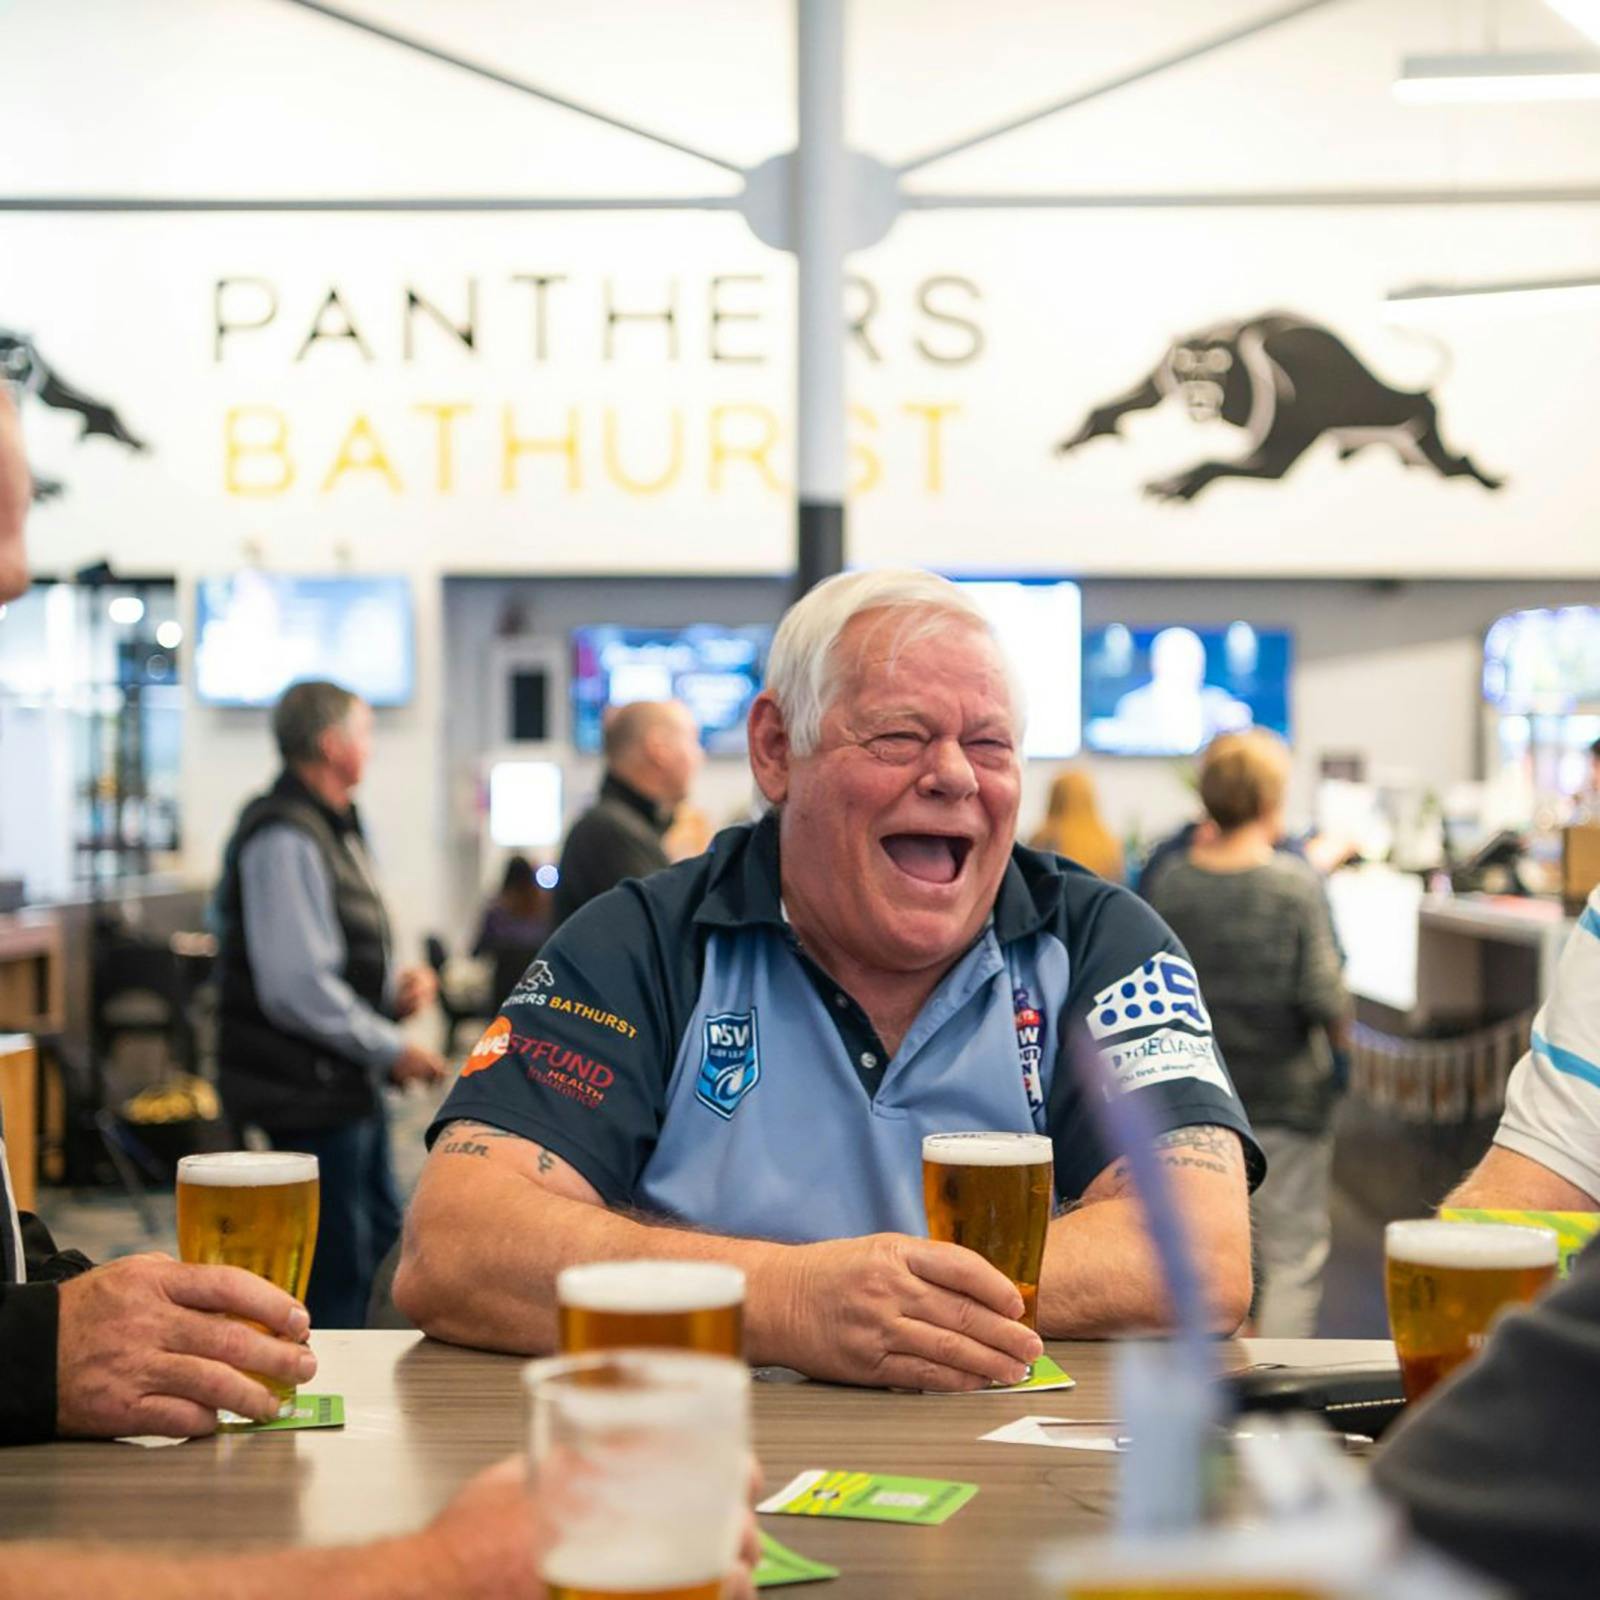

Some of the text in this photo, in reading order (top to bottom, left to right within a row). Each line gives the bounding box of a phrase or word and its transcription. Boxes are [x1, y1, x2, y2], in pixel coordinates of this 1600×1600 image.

[213, 273, 987, 366] PANTHERS
[549, 995, 637, 1039] BATHURST
[547, 1069, 604, 1101] HEALTH
